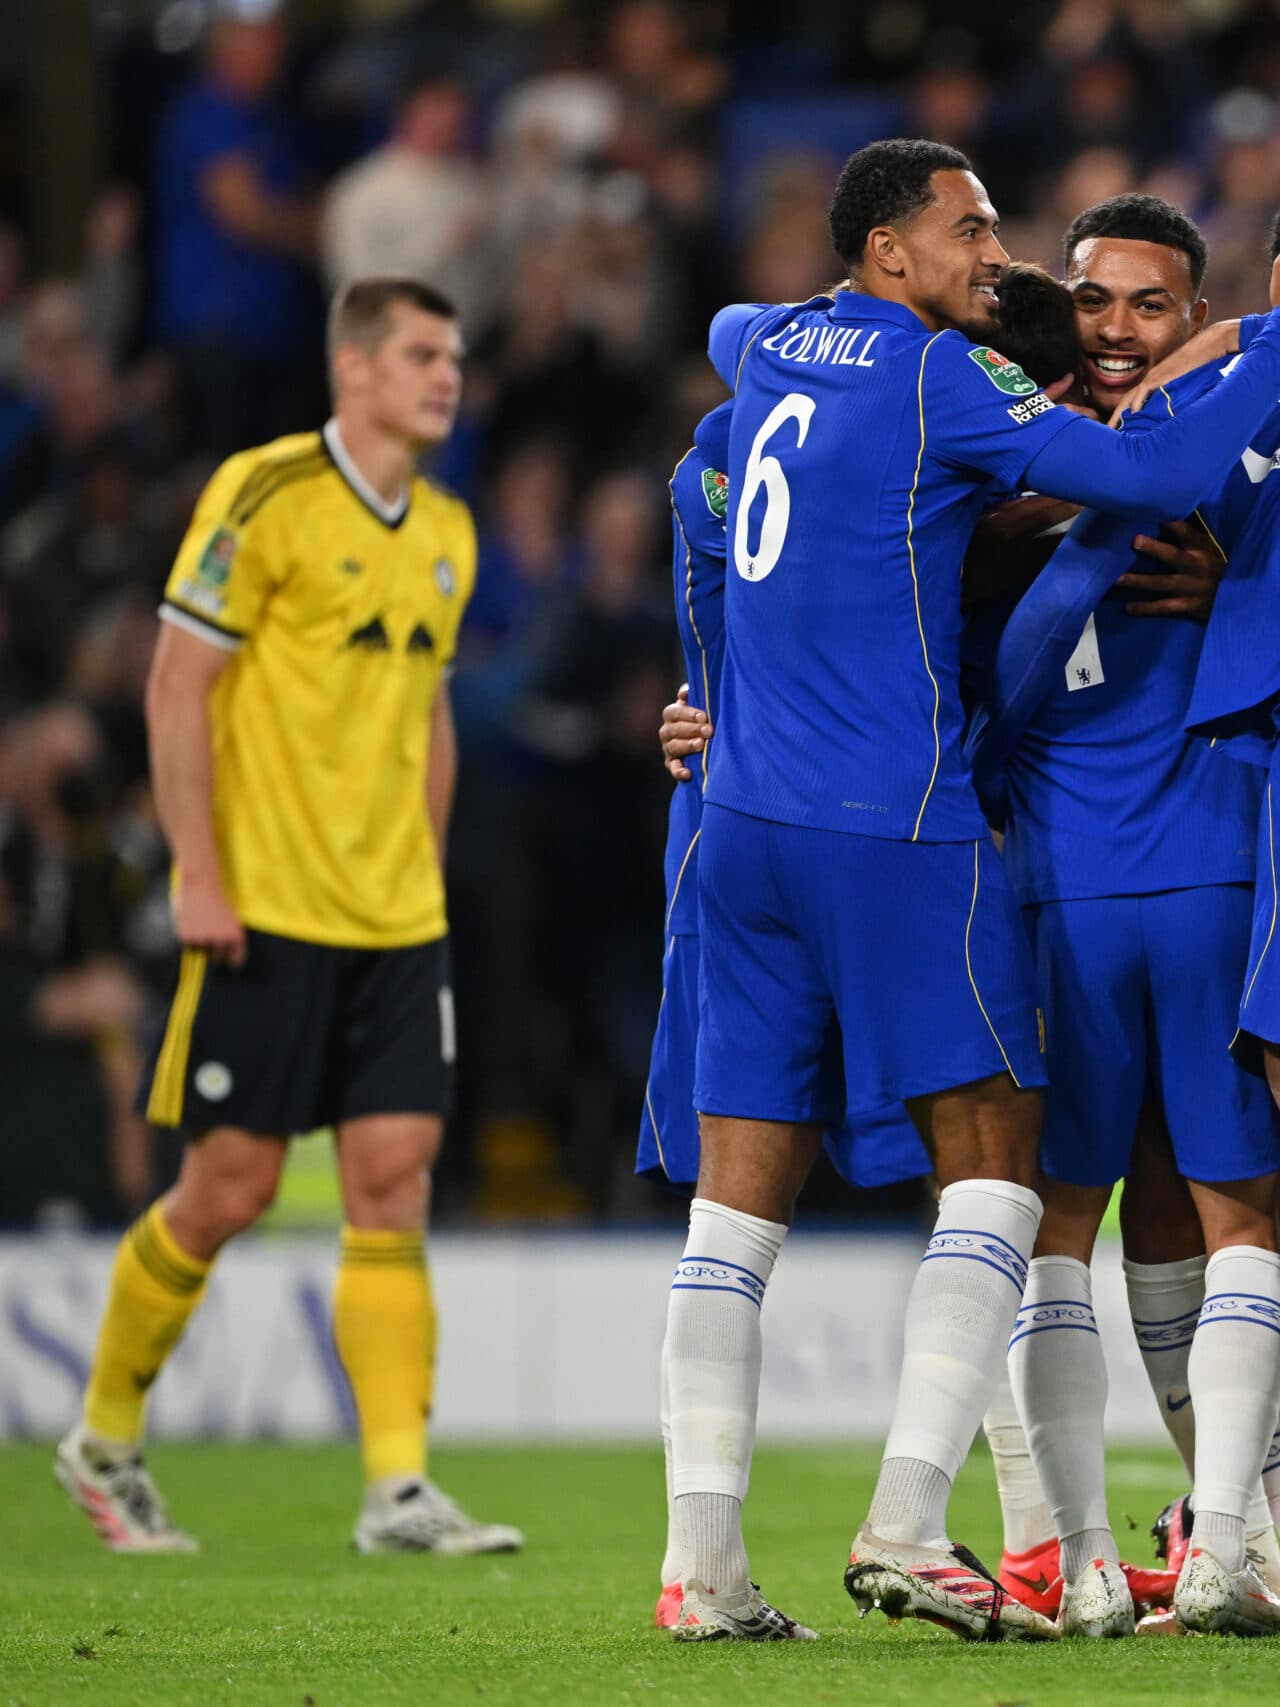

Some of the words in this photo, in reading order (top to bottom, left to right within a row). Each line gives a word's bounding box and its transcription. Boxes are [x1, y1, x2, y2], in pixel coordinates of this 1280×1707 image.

[762, 322, 881, 367] COLWILL
[734, 393, 817, 582] 6
[682, 1267, 729, 1279] CFC
[1033, 1309, 1086, 1321] CFC
